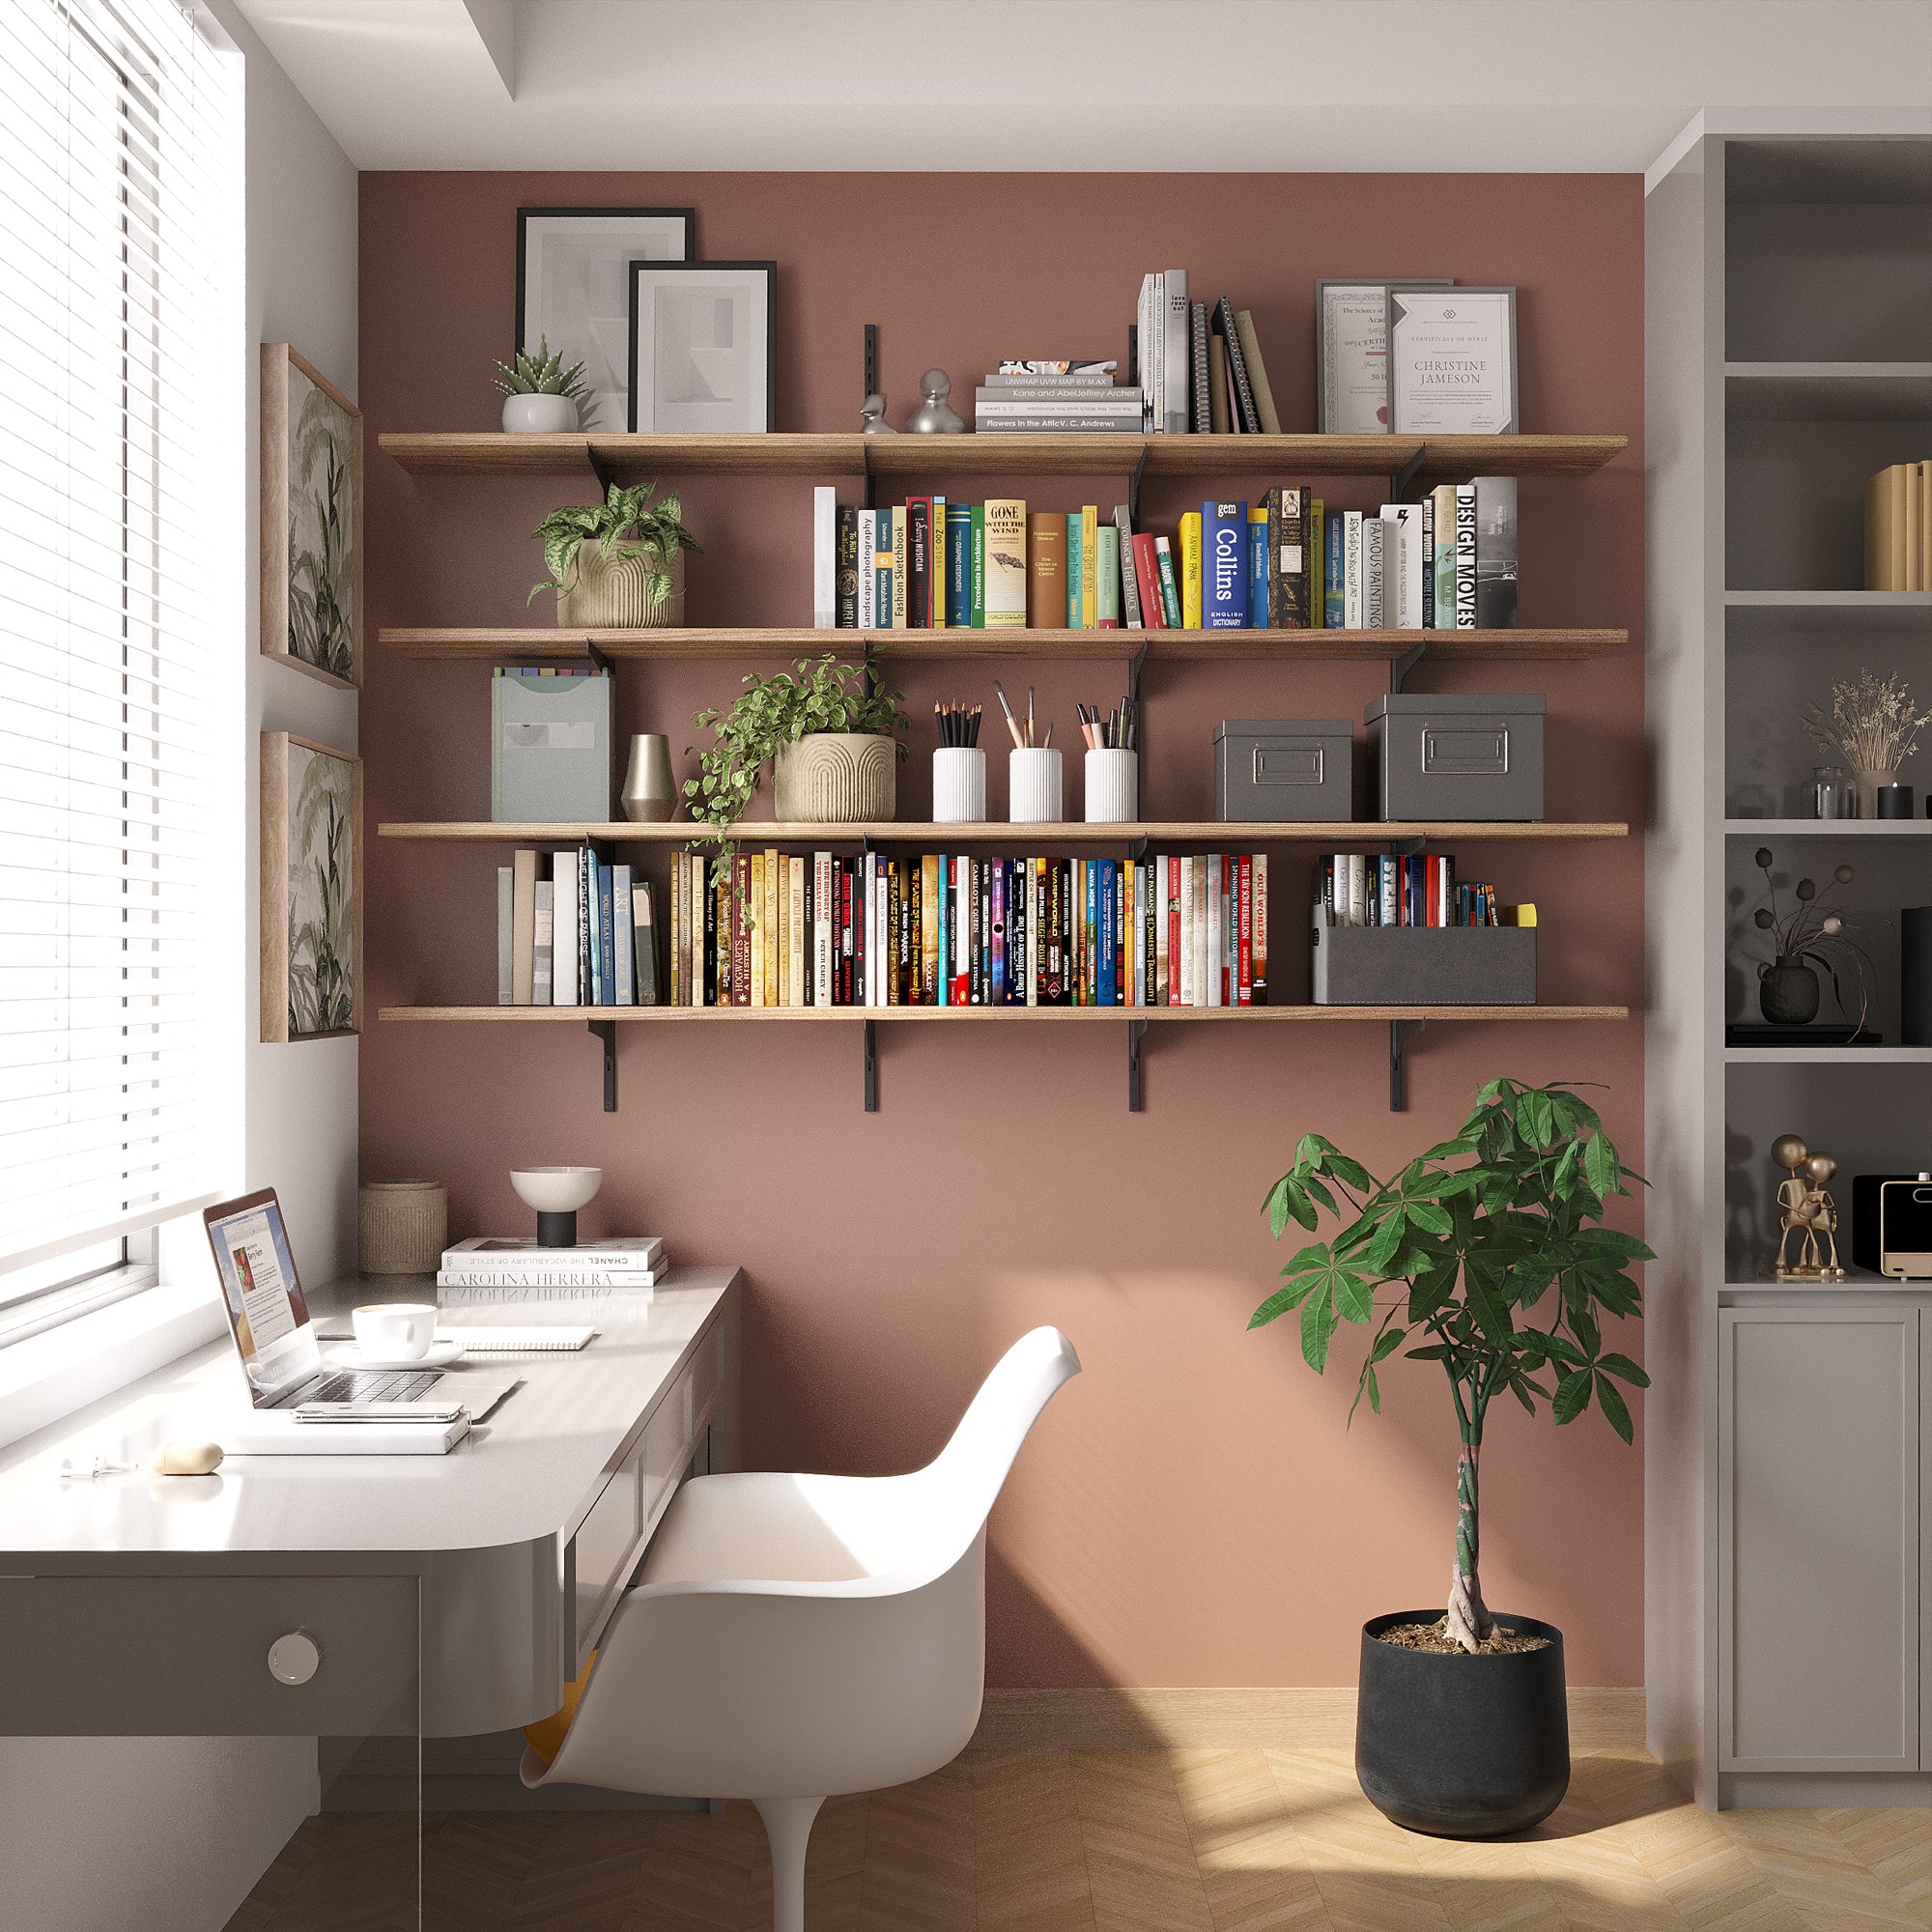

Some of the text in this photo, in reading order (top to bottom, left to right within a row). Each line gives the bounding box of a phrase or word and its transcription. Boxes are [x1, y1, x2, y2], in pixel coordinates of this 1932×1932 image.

[1414, 361, 1487, 371] CHRISTINE
[1420, 374, 1480, 385] JAMESON
[991, 506, 1018, 520] GONE
[1217, 504, 1236, 518] gem
[975, 527, 983, 564] Architecture
[1423, 500, 1432, 562] HOLLOW WORLD
[915, 543, 924, 572] MUSICIAN
[1189, 535, 1198, 560] ANIMAL
[1458, 496, 1475, 626] DESIGN MOVES
[863, 518, 872, 628] Landscape photography
[895, 526, 904, 616] Fashion Sketchbook
[1121, 525, 1136, 612] YOUNG THE SHACK
[1216, 529, 1238, 601] Collins
[1370, 522, 1381, 628] FAMOUS PAINTINGS
[975, 573, 983, 609] Precedents
[616, 887, 628, 915] ART
[843, 873, 852, 900] HISTORY
[582, 906, 587, 920] OF
[843, 902, 852, 925] WORLD
[1147, 922, 1155, 958] DOMESTIC
[735, 939, 744, 991] HOGWARTS
[444, 1273, 612, 1286] CAROLINA HERRERA
